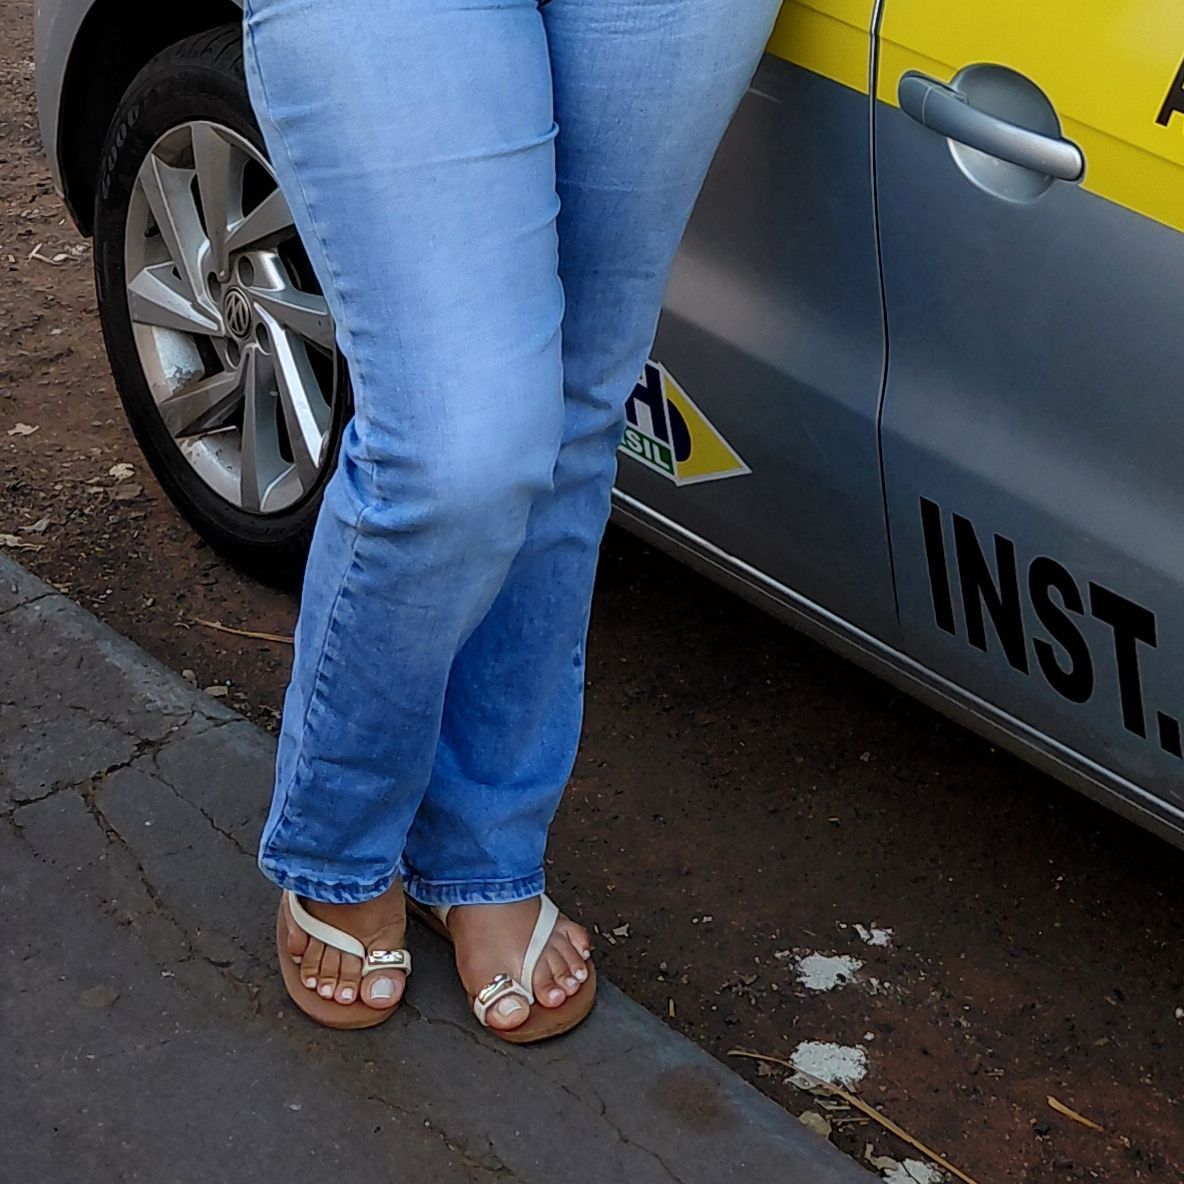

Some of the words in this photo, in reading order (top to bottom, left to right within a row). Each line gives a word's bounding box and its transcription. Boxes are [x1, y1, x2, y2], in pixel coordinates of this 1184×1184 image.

[624, 362, 670, 445] H
[620, 428, 671, 471] SIL
[919, 496, 1184, 761] INST.
